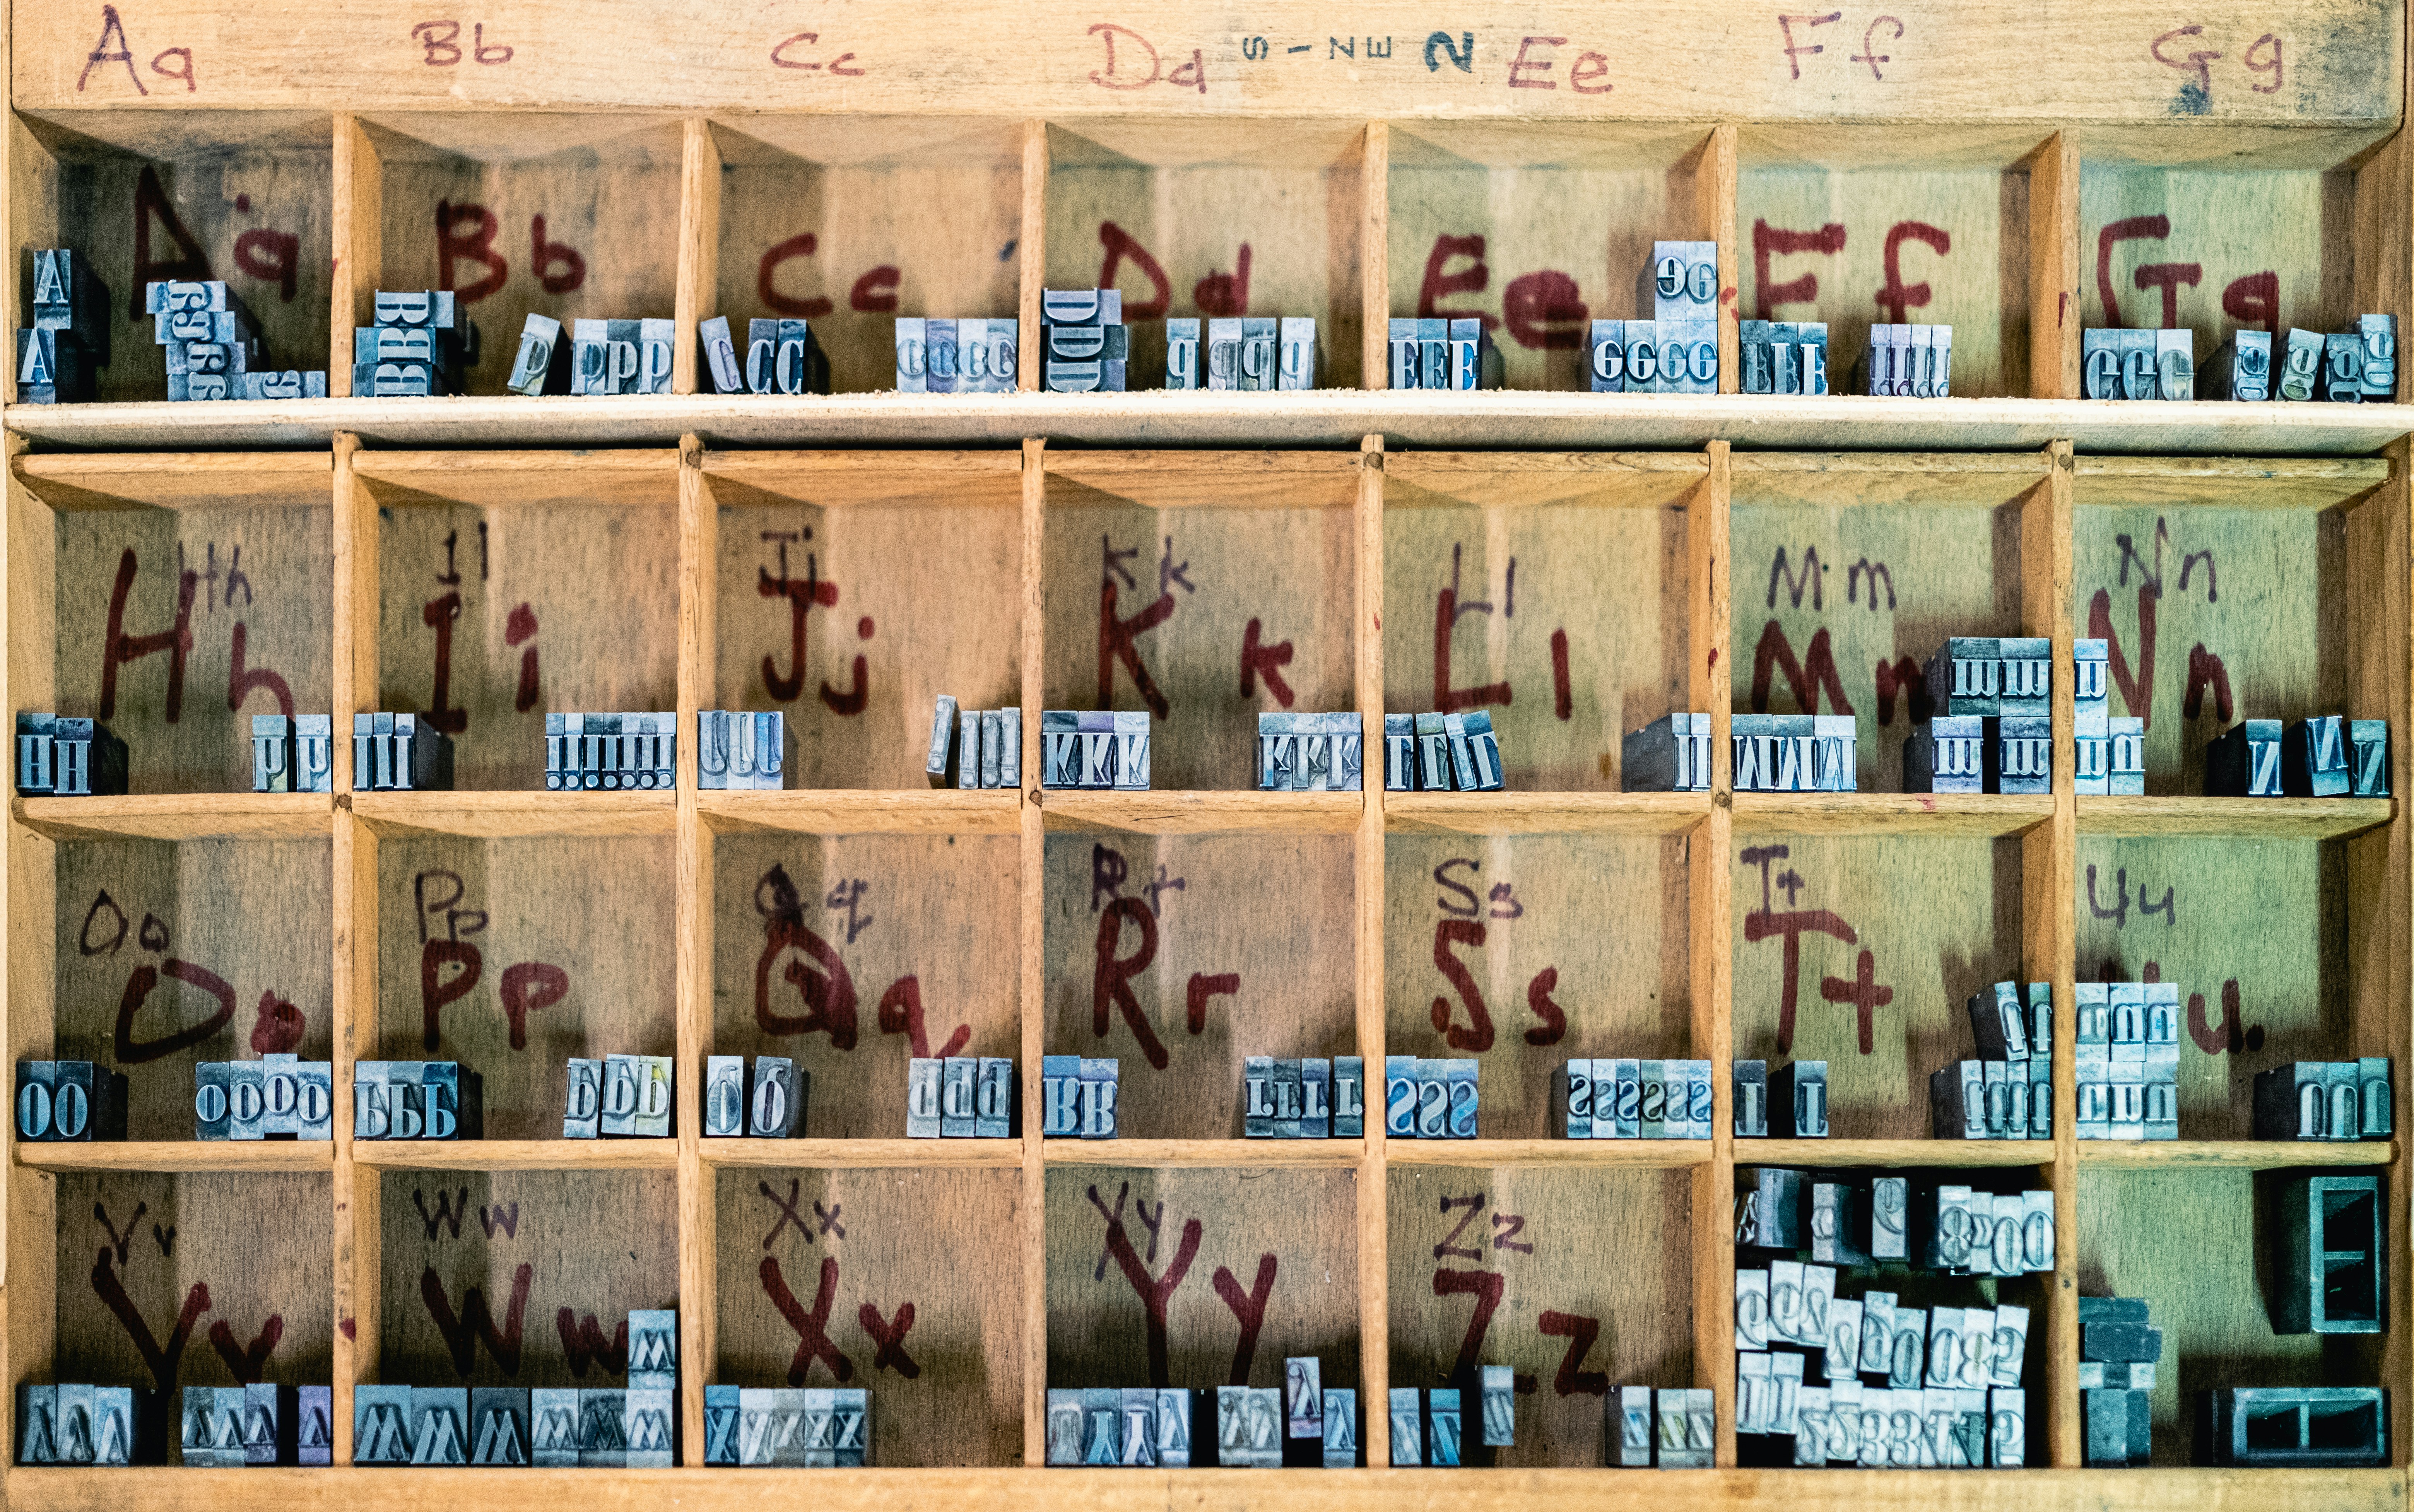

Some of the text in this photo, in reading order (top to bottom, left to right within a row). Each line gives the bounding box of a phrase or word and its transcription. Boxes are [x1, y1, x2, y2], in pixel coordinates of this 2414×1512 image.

[412, 21, 513, 66] Bb
[770, 32, 865, 75] Cc
[1087, 23, 1207, 94] Dd
[1508, 36, 1613, 94] Ee
[1778, 12, 1904, 80] Ff
[2151, 26, 2282, 94] Gg
[438, 199, 586, 304] Bb
[757, 233, 901, 317] Cc
[1099, 221, 1253, 319] Dd
[1419, 234, 1590, 349] Ee
[1753, 219, 1950, 325] Ff
[1103, 532, 1197, 593] Kk
[1767, 544, 1896, 612] Mm
[2117, 515, 2217, 603] Nn
[100, 547, 294, 724] Hh
[423, 592, 540, 734] Ii
[757, 579, 876, 715] Jj
[1097, 581, 1295, 721] Kk
[414, 869, 489, 944] Pp
[1434, 857, 1523, 919] Ss
[422, 939, 571, 1054] Pp
[1092, 896, 1241, 1070] Rr
[1430, 919, 1567, 1053] Ss
[1744, 909, 1894, 1056] Tt
[413, 1187, 520, 1242] Ww
[759, 1178, 846, 1251] Xx
[1434, 1192, 1534, 1262] Zz
[759, 1254, 922, 1386] Xx
